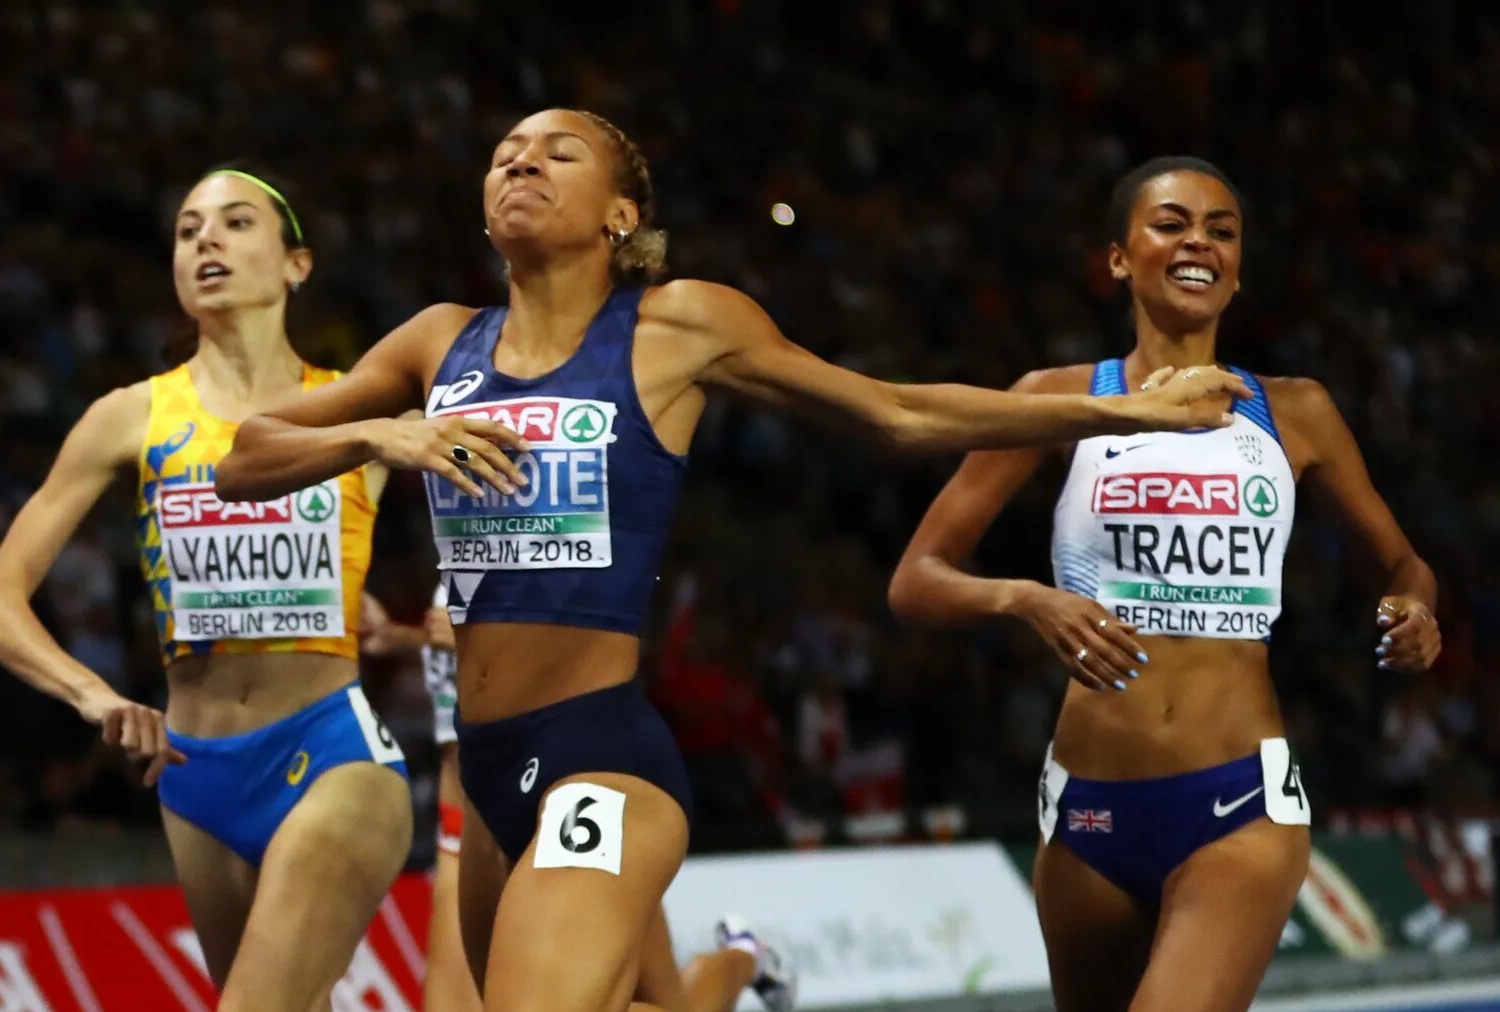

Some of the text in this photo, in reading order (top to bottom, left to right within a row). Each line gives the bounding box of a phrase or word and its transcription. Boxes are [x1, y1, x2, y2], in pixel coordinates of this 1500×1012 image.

[1104, 476, 1236, 511] SPAR
[470, 519, 503, 533] RUN
[168, 532, 334, 582] LYAKHOVA
[451, 539, 593, 564] BERLIN 2018
[1104, 523, 1275, 577] TRACEY
[1150, 585, 1186, 601] RUN
[188, 611, 328, 635] BERLIN 2018
[1115, 604, 1271, 634] BERLIN 2018
[1282, 752, 1304, 810] 4
[559, 795, 602, 854] 6
